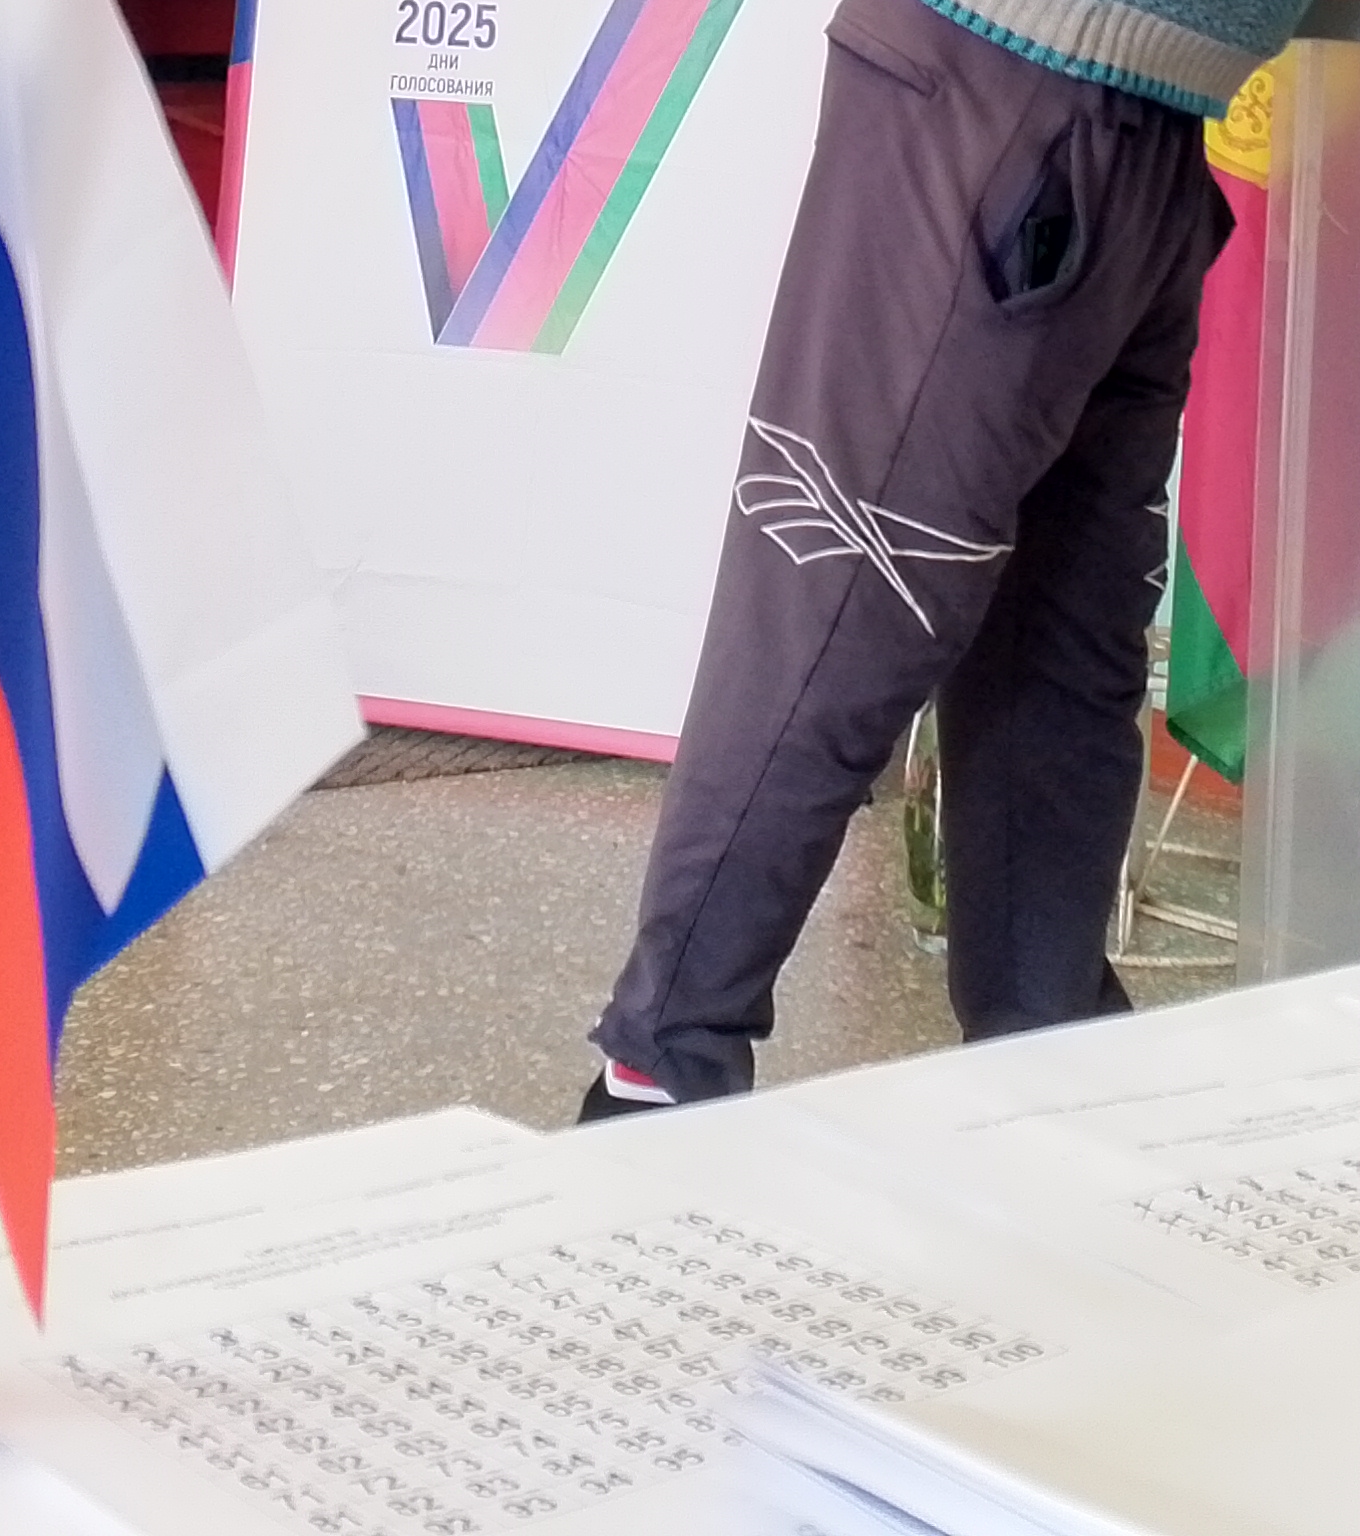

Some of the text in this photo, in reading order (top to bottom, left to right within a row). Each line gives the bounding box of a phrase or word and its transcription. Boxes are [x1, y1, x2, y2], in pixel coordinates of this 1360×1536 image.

[395, 0, 498, 49] 2025
[427, 53, 459, 71] ДНИ
[390, 74, 493, 97] ГОЛОСОВАНИЯ
